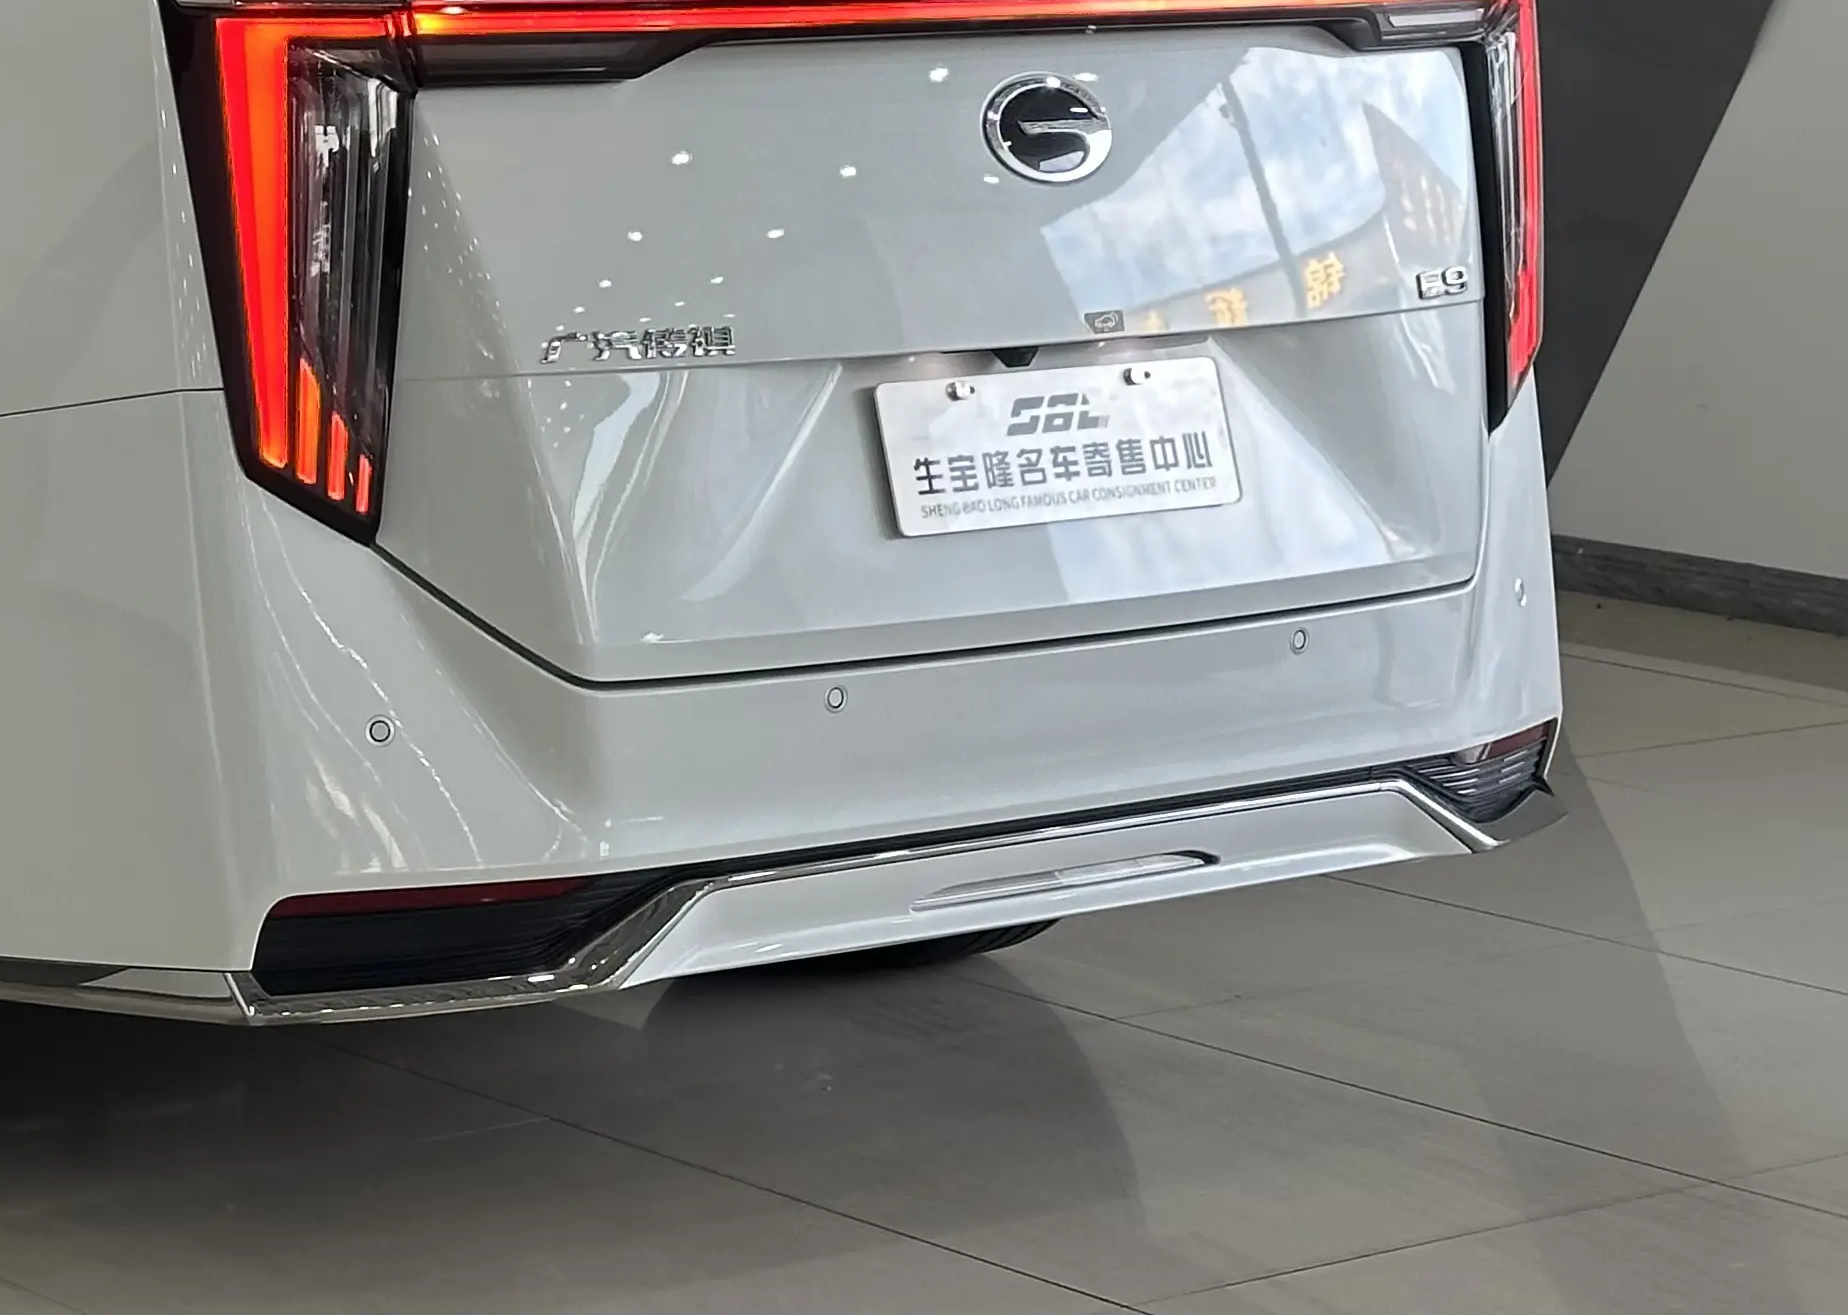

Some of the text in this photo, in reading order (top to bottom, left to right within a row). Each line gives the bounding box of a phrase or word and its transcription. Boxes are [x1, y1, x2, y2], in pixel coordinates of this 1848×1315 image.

[913, 430, 1213, 495] 生宝隆名车寄售中心
[988, 493, 1020, 512] LONG
[1021, 490, 1067, 509] FAMOUS
[1068, 487, 1090, 504] CAR
[1174, 474, 1216, 494] CENTER
